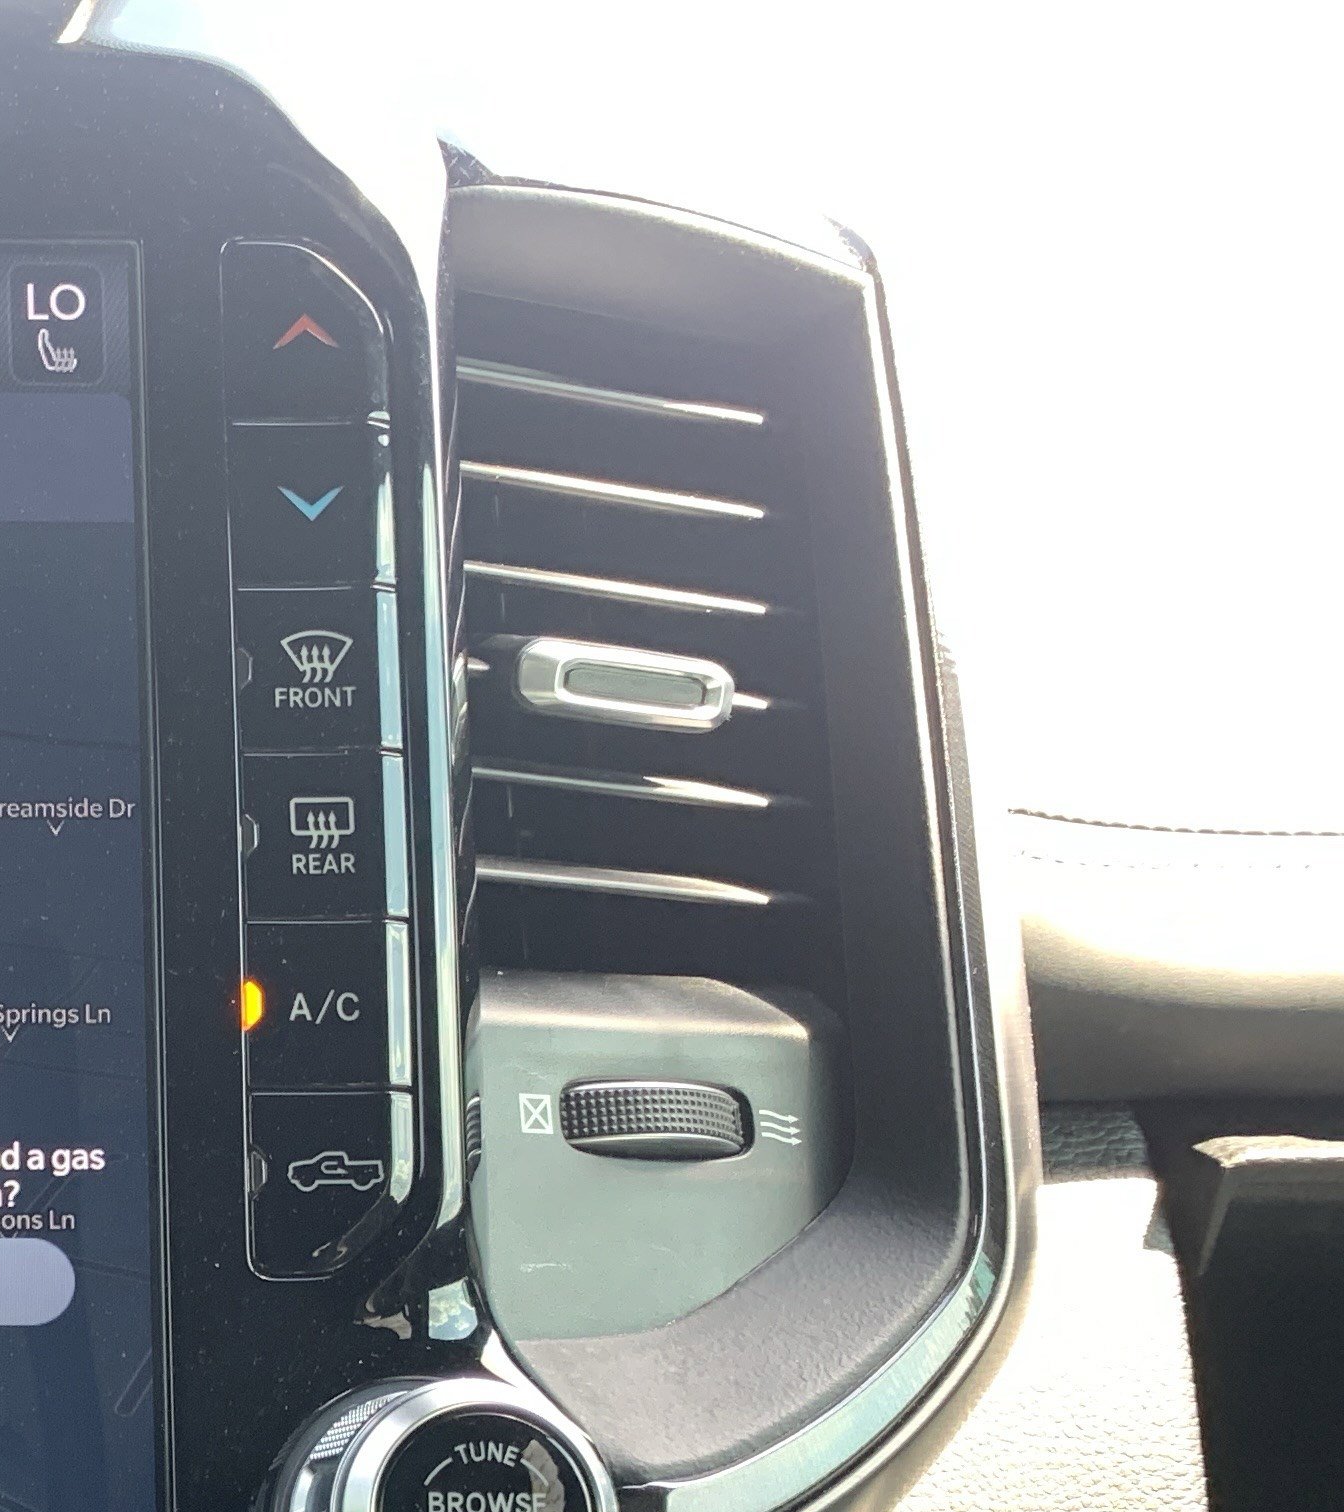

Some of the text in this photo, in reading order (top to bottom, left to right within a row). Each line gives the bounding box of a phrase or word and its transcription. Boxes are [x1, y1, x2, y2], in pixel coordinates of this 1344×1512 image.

[26, 284, 86, 322] LO
[275, 687, 356, 708] FRONT
[109, 799, 135, 819] Dr
[292, 853, 355, 876] REAR
[85, 1004, 111, 1024] Ln
[290, 991, 361, 1025] A/C
[28, 1149, 45, 1170] a
[51, 1149, 105, 1178] gas
[49, 1210, 75, 1229] Ln
[455, 1440, 521, 1468] TUNE
